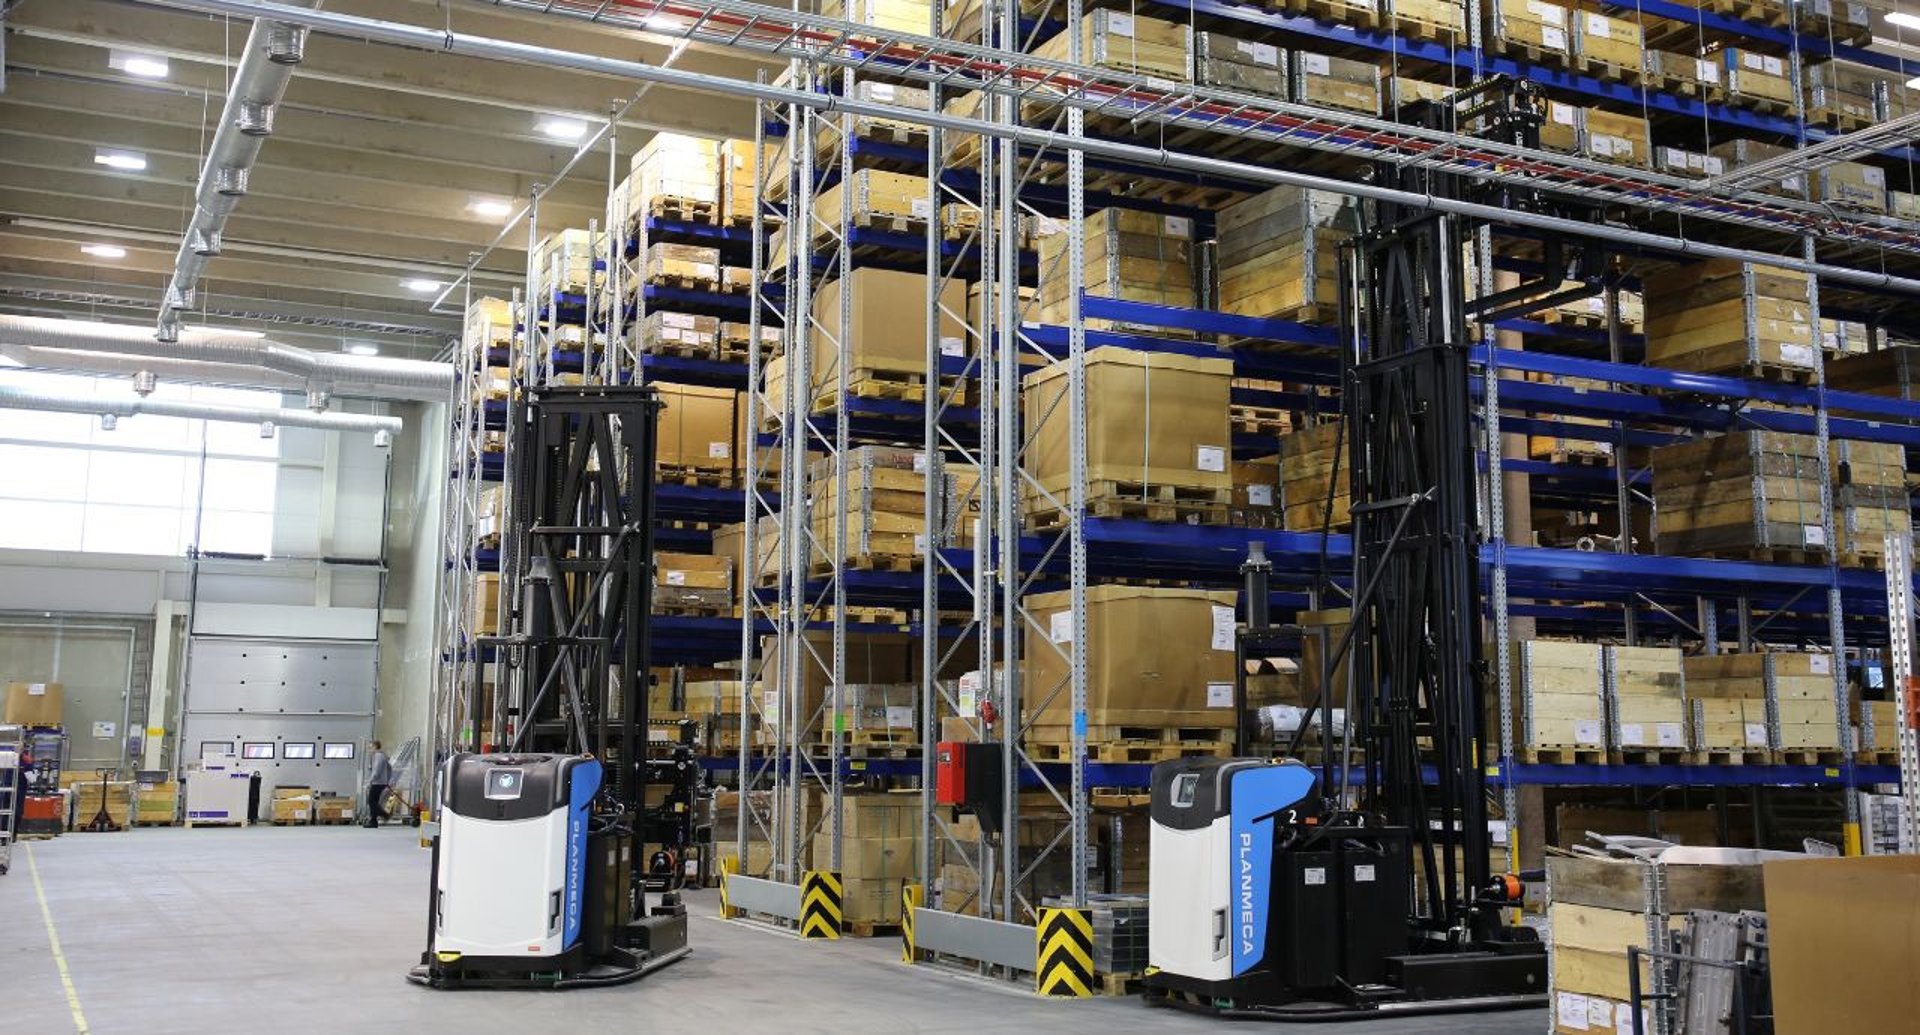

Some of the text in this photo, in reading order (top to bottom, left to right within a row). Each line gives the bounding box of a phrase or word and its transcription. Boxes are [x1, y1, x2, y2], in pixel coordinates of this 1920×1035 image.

[1289, 809, 1297, 824] 2
[569, 820, 580, 932] PLANMECA
[1240, 833, 1254, 956] PLANMECA
